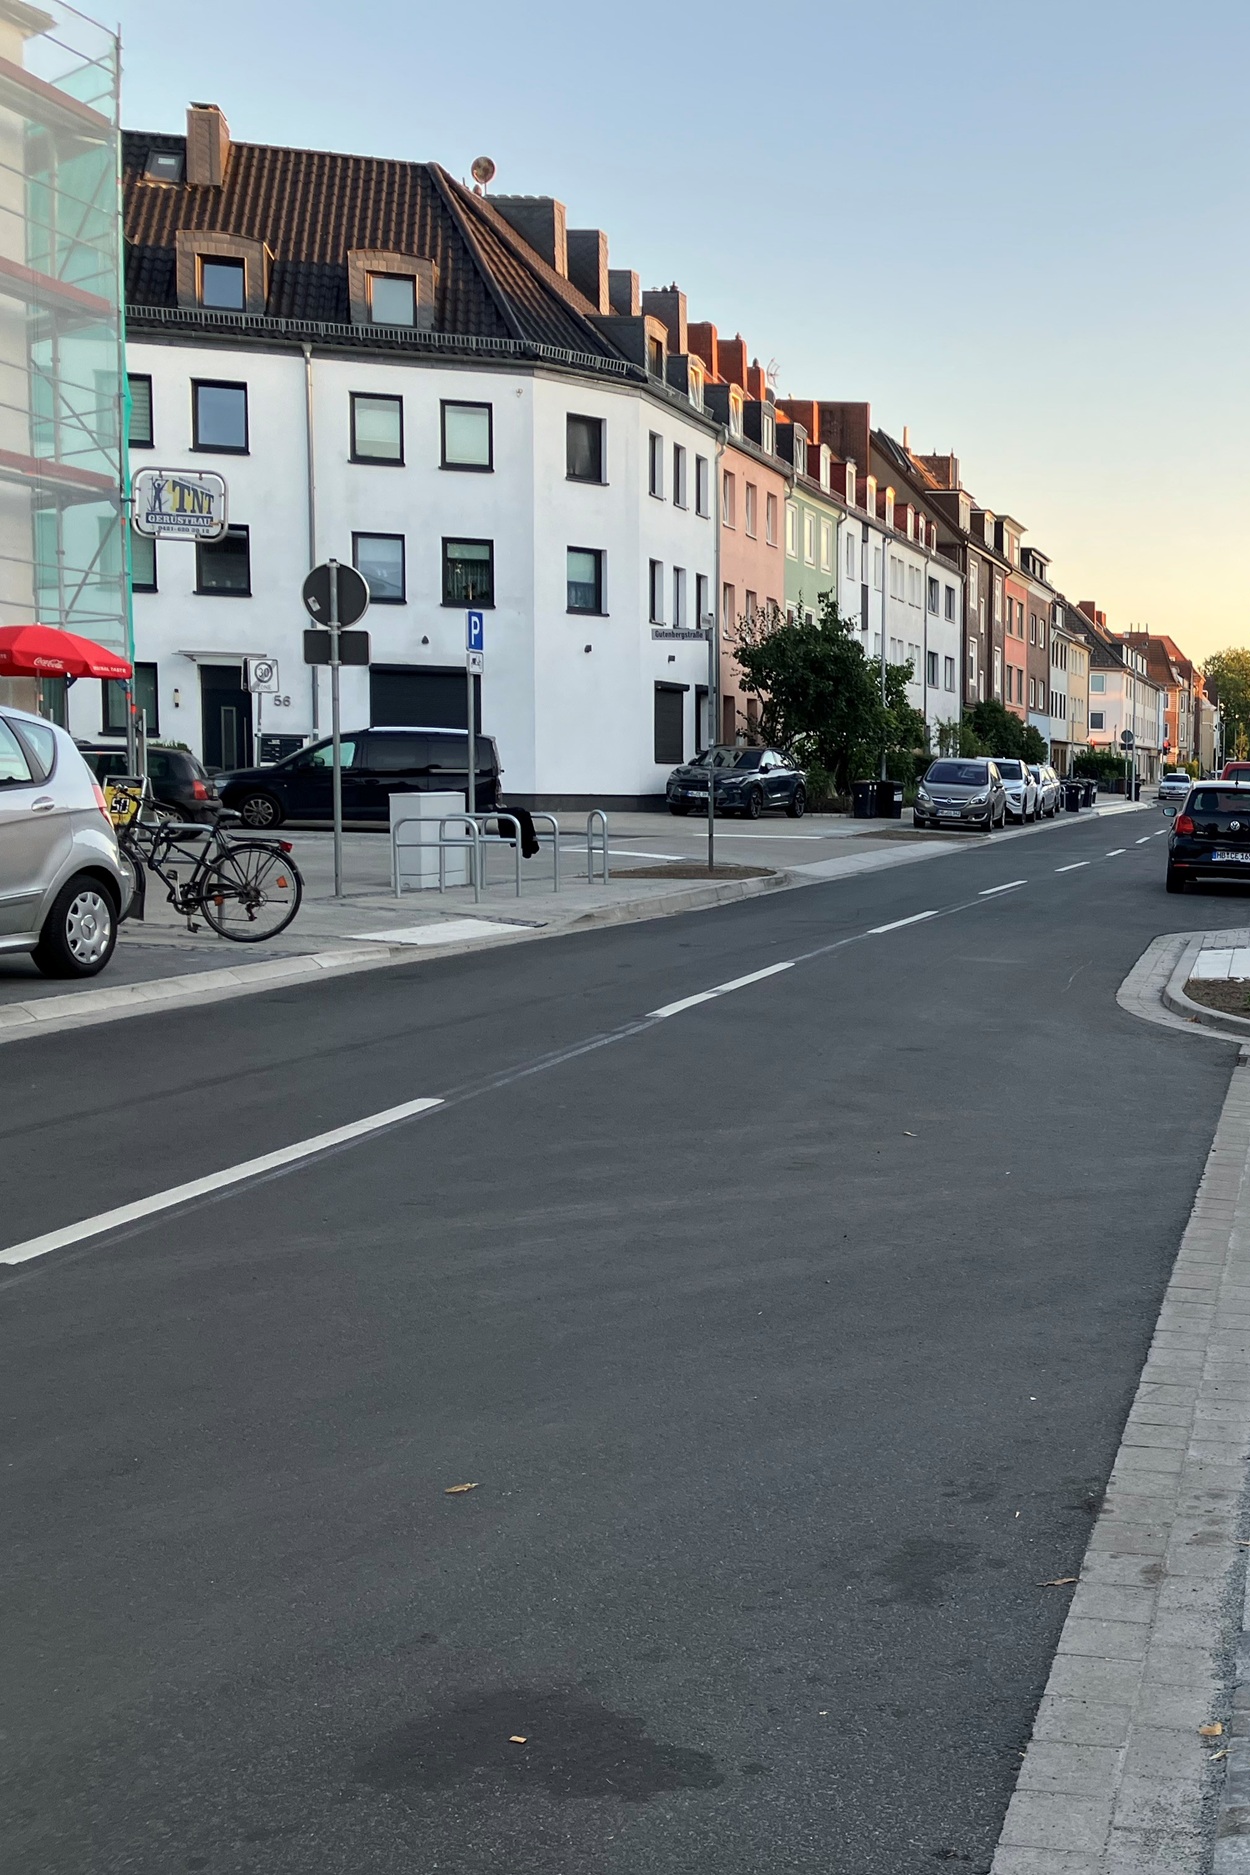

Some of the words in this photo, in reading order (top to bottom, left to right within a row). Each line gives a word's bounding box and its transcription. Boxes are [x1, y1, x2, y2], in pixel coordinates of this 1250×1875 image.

[172, 480, 214, 514] TNT
[148, 514, 211, 526] GERÜSTBAU
[471, 615, 480, 646] P
[654, 630, 703, 640] Gutenbergstraße
[258, 667, 271, 678] 30
[273, 694, 292, 707] 56
